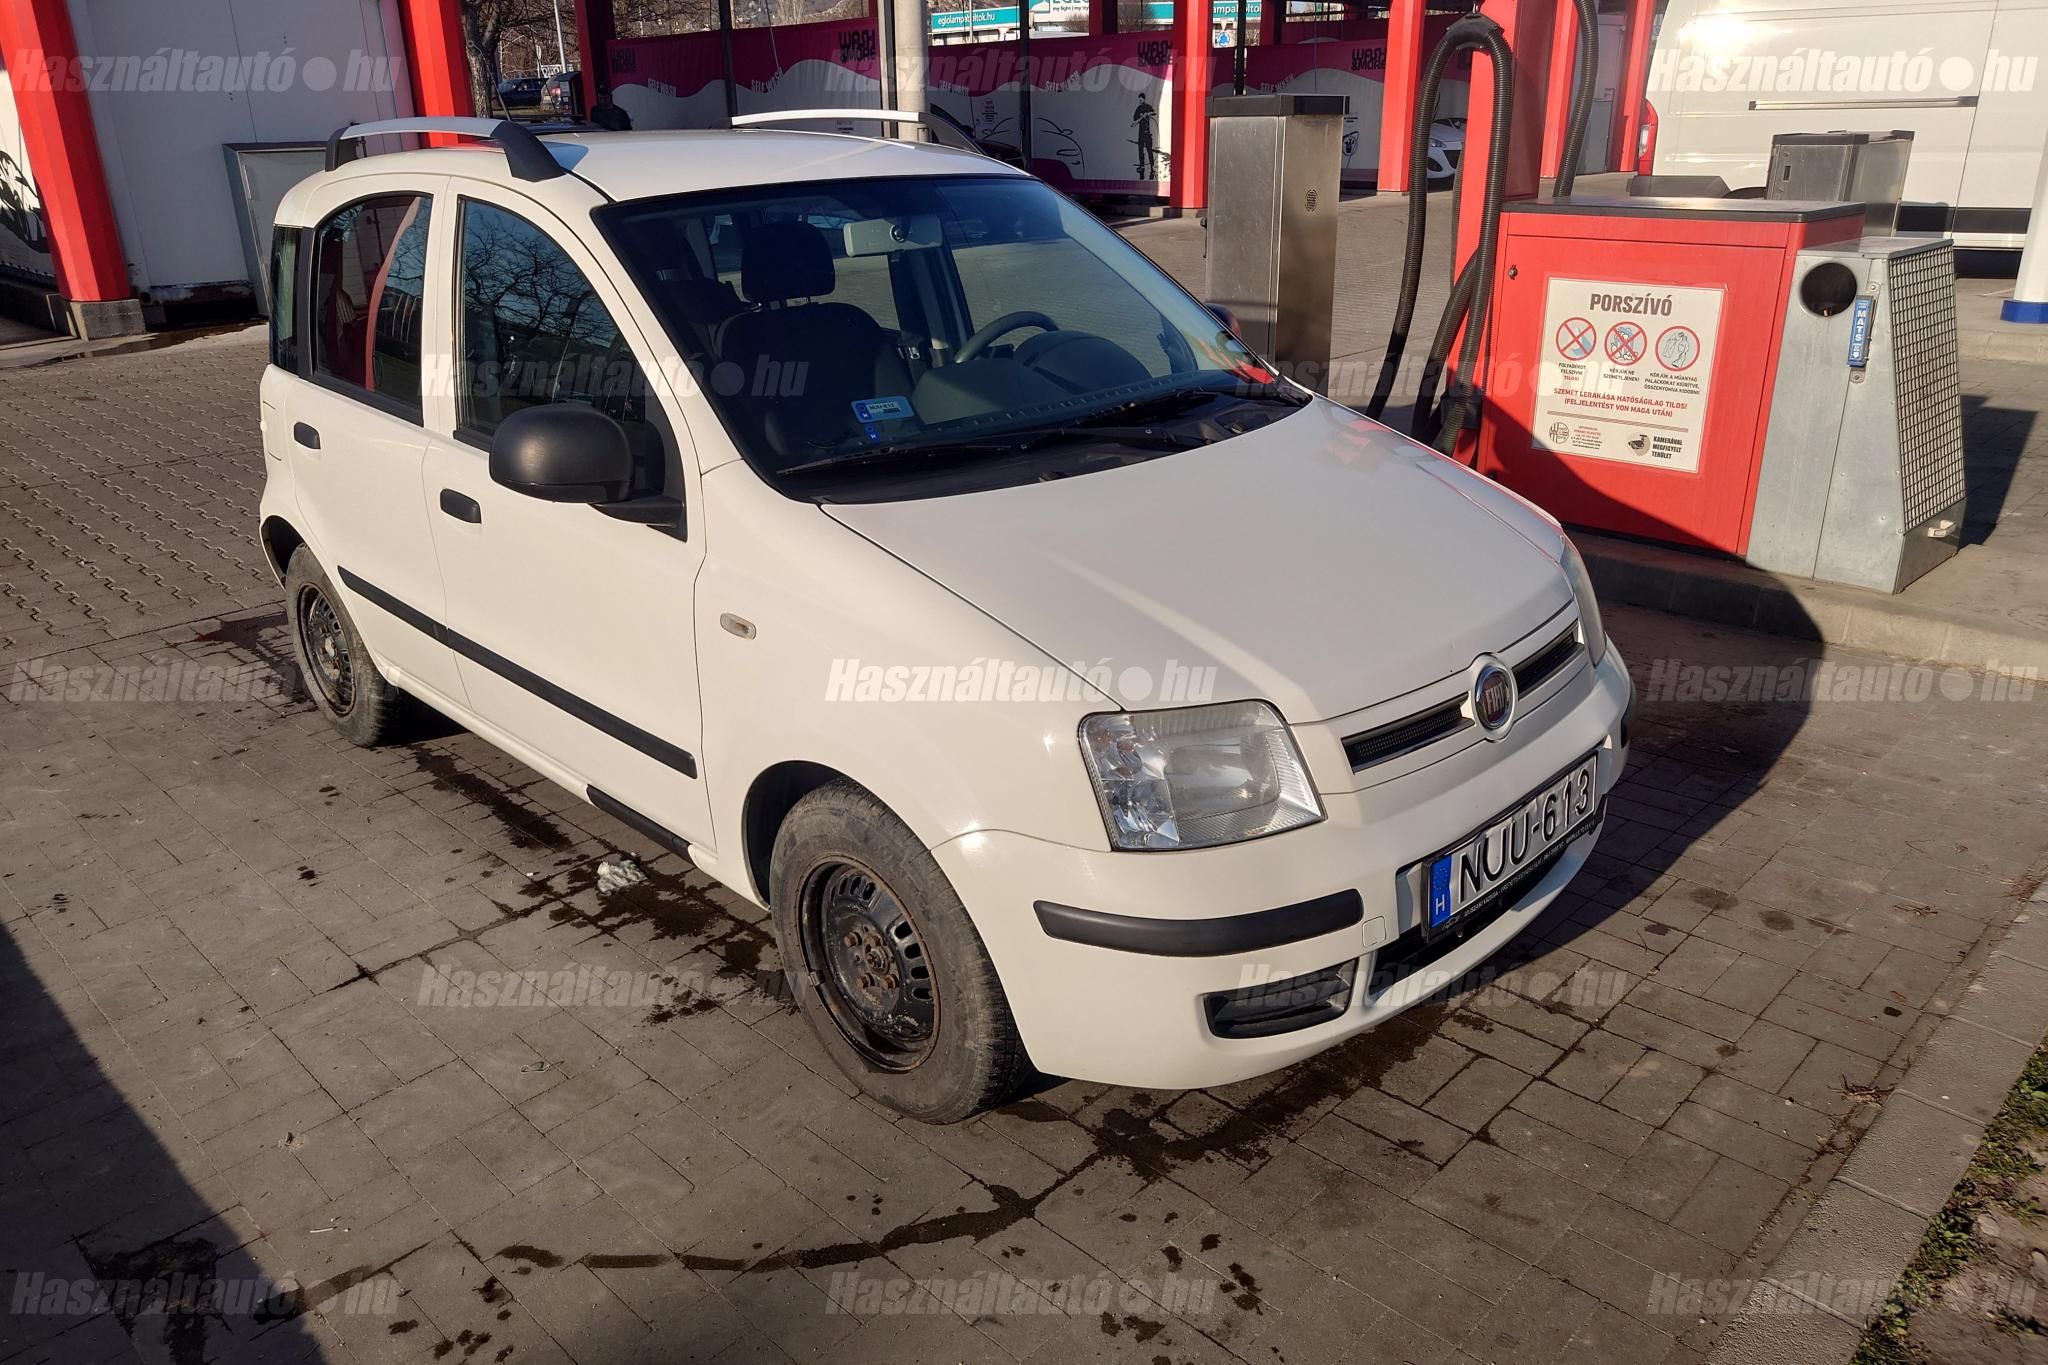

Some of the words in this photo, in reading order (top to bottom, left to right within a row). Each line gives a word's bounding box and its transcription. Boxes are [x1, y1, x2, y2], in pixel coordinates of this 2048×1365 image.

[1352, 48, 1386, 60] WASH
[1590, 293, 1672, 317] PORSZÍVÓ
[1855, 310, 1866, 341] MATS
[1564, 398, 1614, 410] (FELJELENTÉST
[1630, 406, 1650, 415] MAGA
[1580, 390, 1615, 400] LERAKÁSA
[1616, 395, 1664, 407] HATÓSÁGILAG
[1666, 400, 1688, 409] TILOS!
[1652, 443, 1682, 453] MEGFIGYELT
[1653, 435, 1683, 446] KAMERÁVAL
[1652, 450, 1672, 460] TERÜLET
[1485, 681, 1506, 715] FIAT
[1458, 767, 1591, 904] NUU-613
[1436, 894, 1445, 915] H
